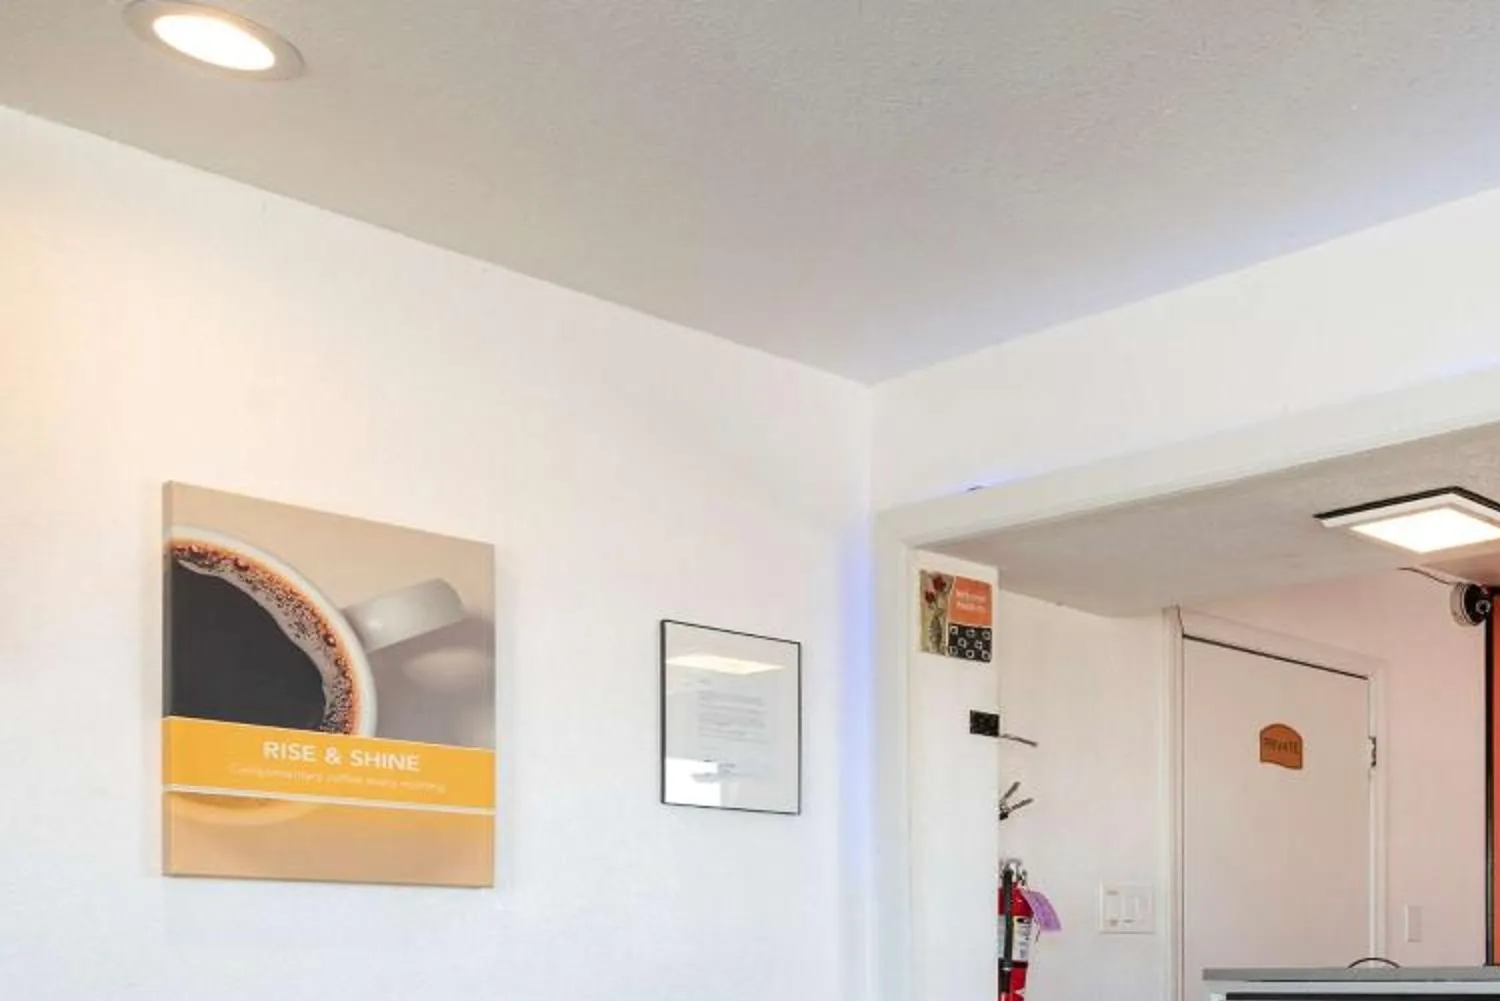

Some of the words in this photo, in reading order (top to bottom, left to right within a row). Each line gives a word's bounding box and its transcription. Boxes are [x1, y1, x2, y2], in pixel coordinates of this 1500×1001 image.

[263, 740, 316, 763] RISE
[323, 746, 342, 765] &
[350, 749, 420, 772] SHINE
